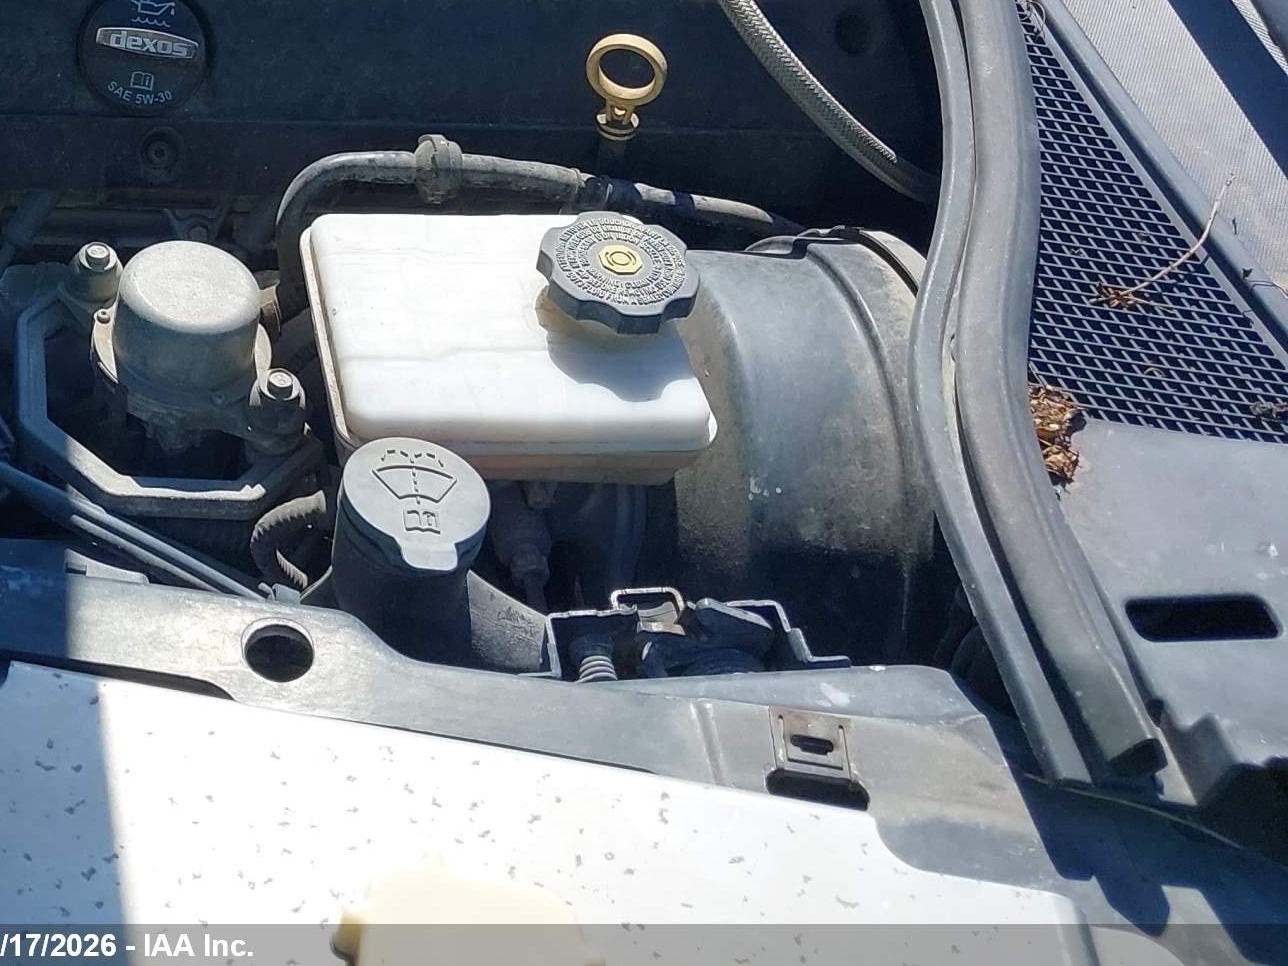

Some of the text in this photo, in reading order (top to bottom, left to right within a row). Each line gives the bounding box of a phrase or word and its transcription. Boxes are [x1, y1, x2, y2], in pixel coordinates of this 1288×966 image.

[111, 31, 187, 57] dexos
[107, 81, 173, 105] SAE 5W-30
